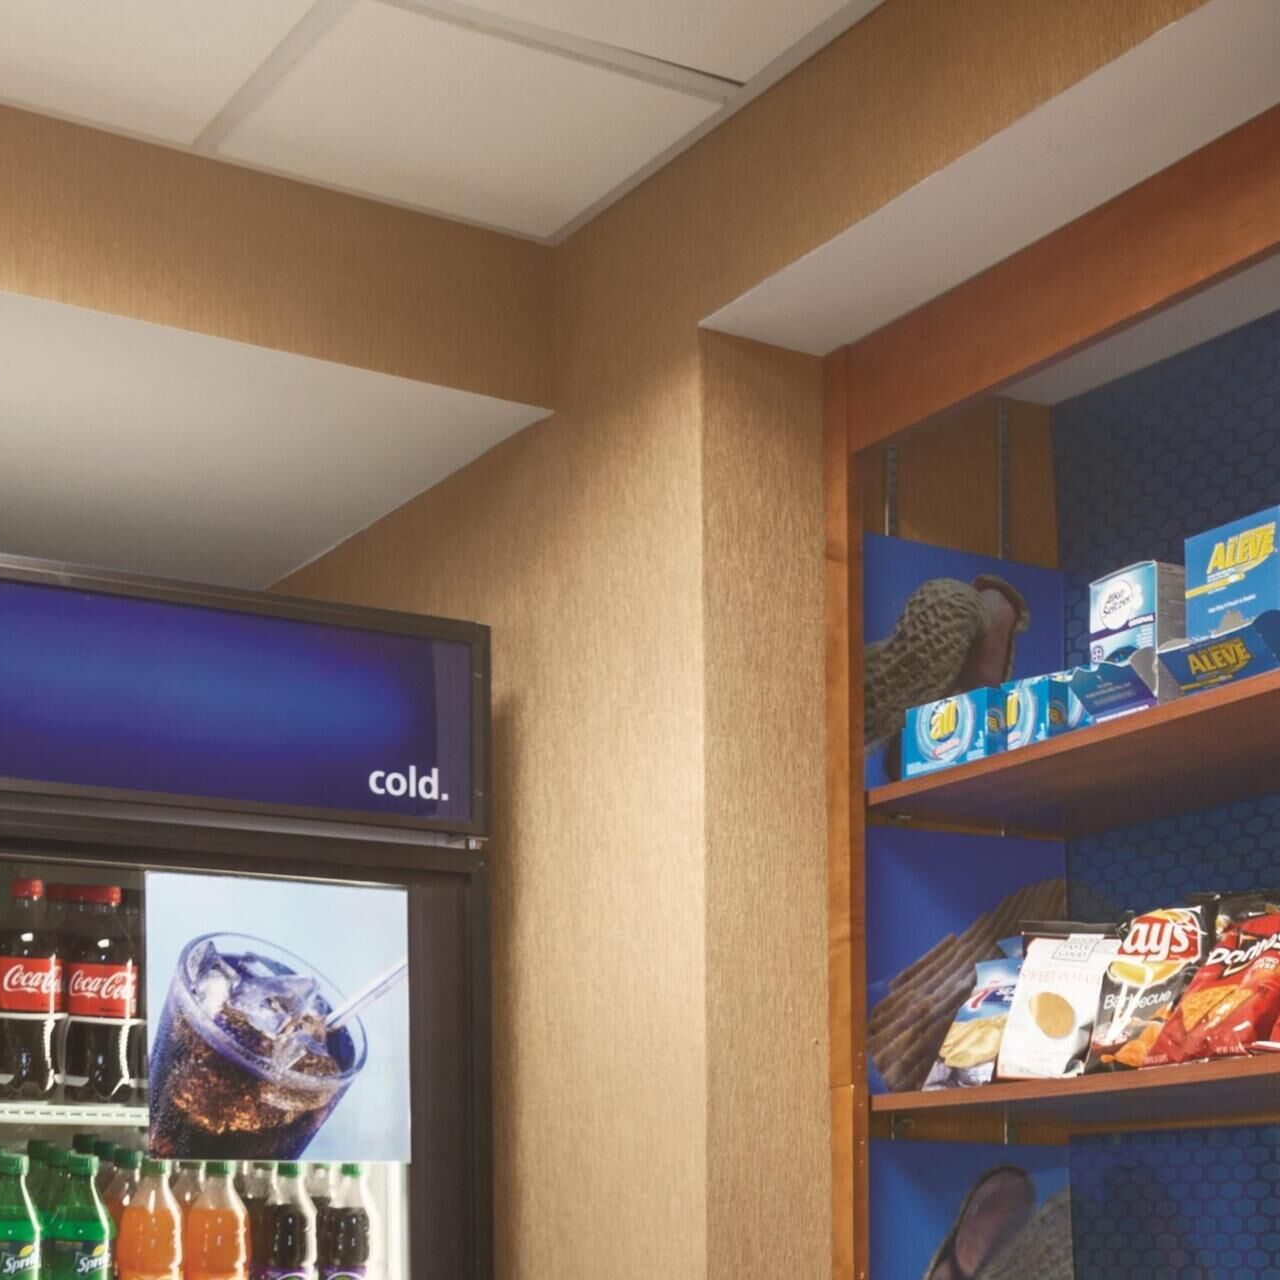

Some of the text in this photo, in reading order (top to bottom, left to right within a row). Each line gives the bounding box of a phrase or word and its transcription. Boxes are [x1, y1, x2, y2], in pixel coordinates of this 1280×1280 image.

[1207, 522, 1276, 574] ALEVE
[1188, 640, 1251, 675] ALEVE
[930, 699, 958, 741] all
[368, 765, 449, 801] cold.
